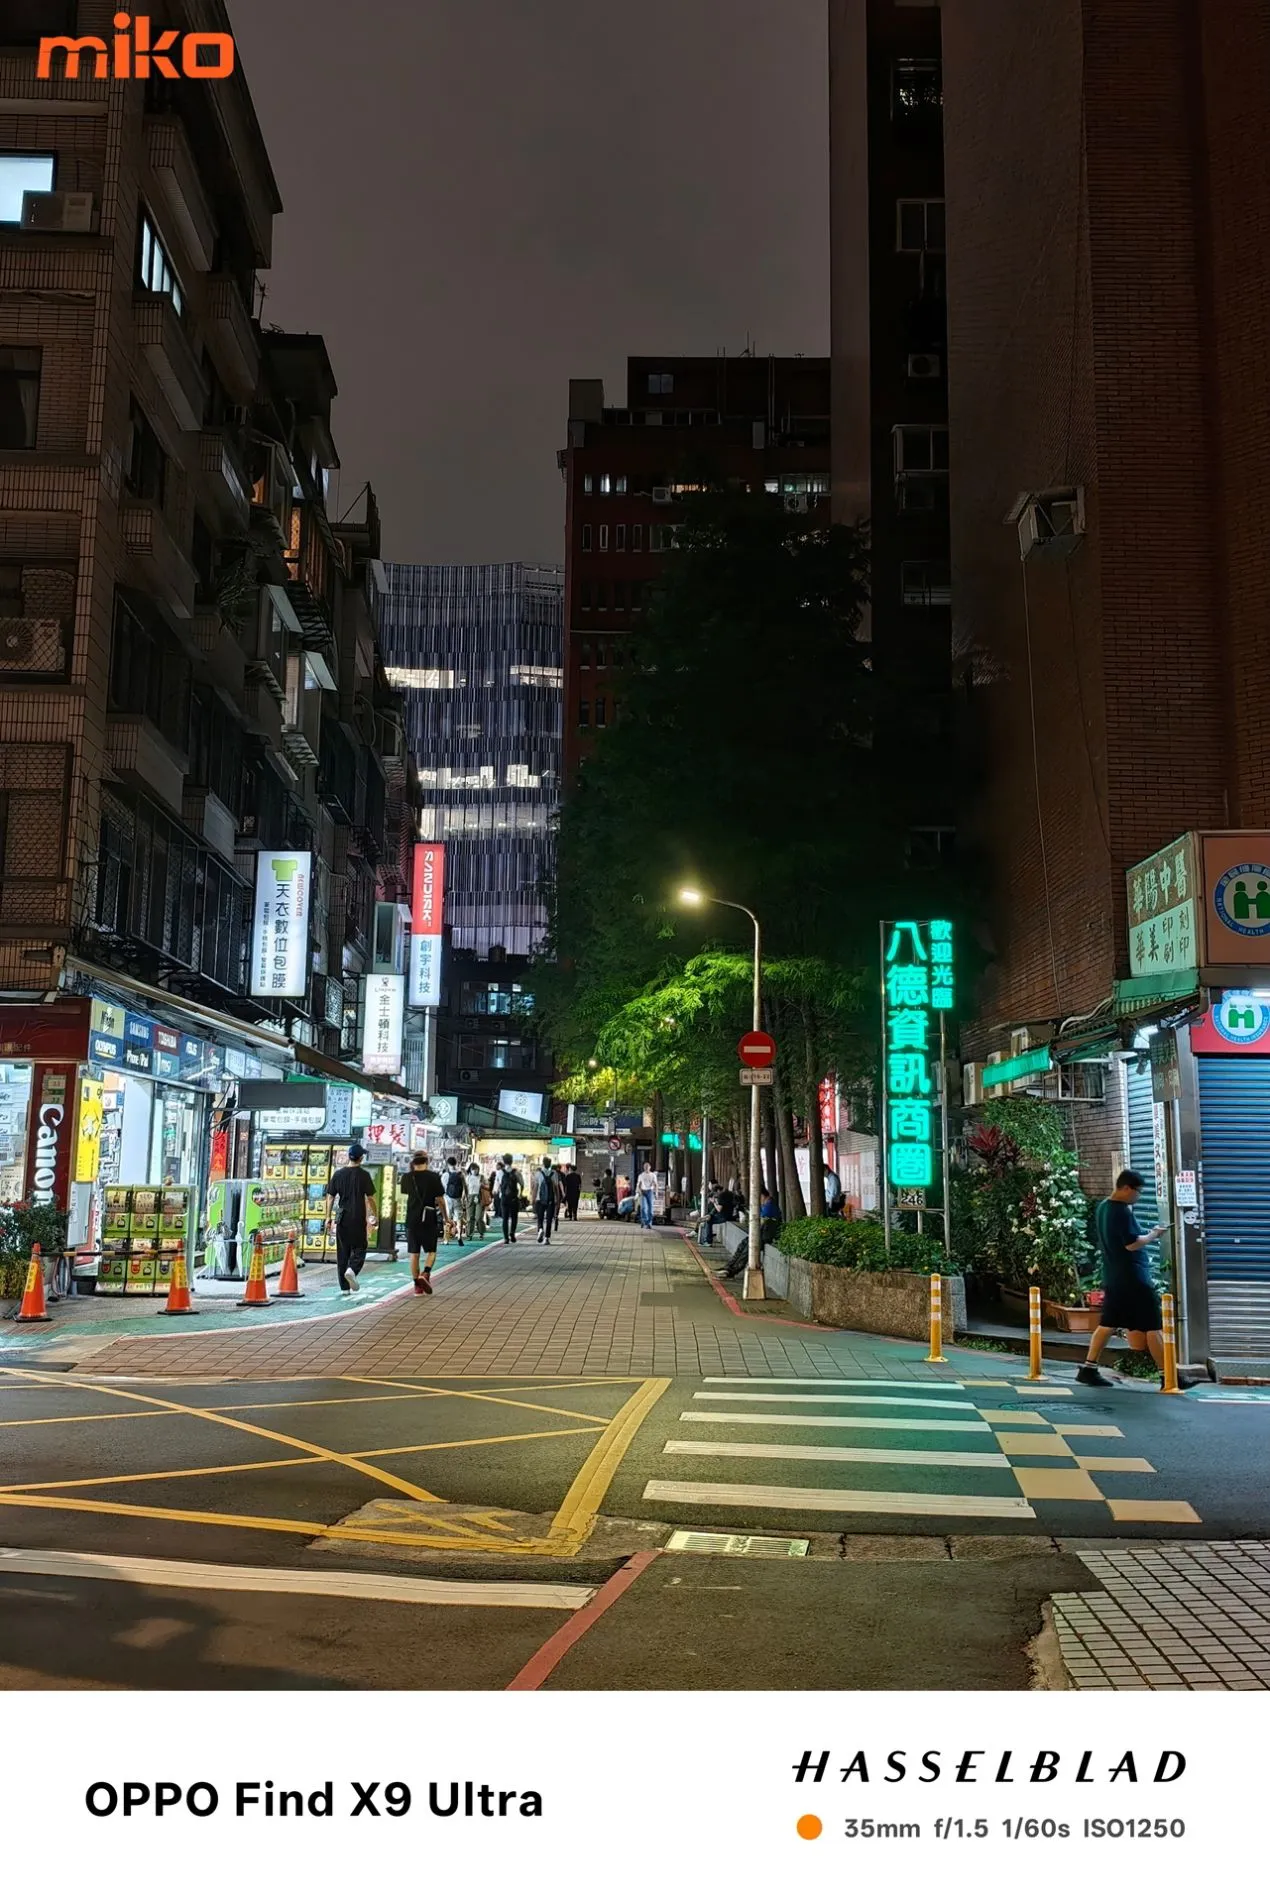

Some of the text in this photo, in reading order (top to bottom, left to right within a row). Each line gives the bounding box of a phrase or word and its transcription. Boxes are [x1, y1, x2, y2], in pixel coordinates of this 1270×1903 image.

[1133, 848, 1188, 923] 華陽中醫
[271, 883, 291, 989] 天衣數位包膜
[930, 920, 954, 1009] 歡迎光臨
[1136, 923, 1159, 969] 華美
[1238, 927, 1264, 936] HEALTH
[886, 921, 933, 1186] 八德資訊商圈
[33, 1103, 64, 1208] Canon
[900, 1194, 923, 1206] 246
